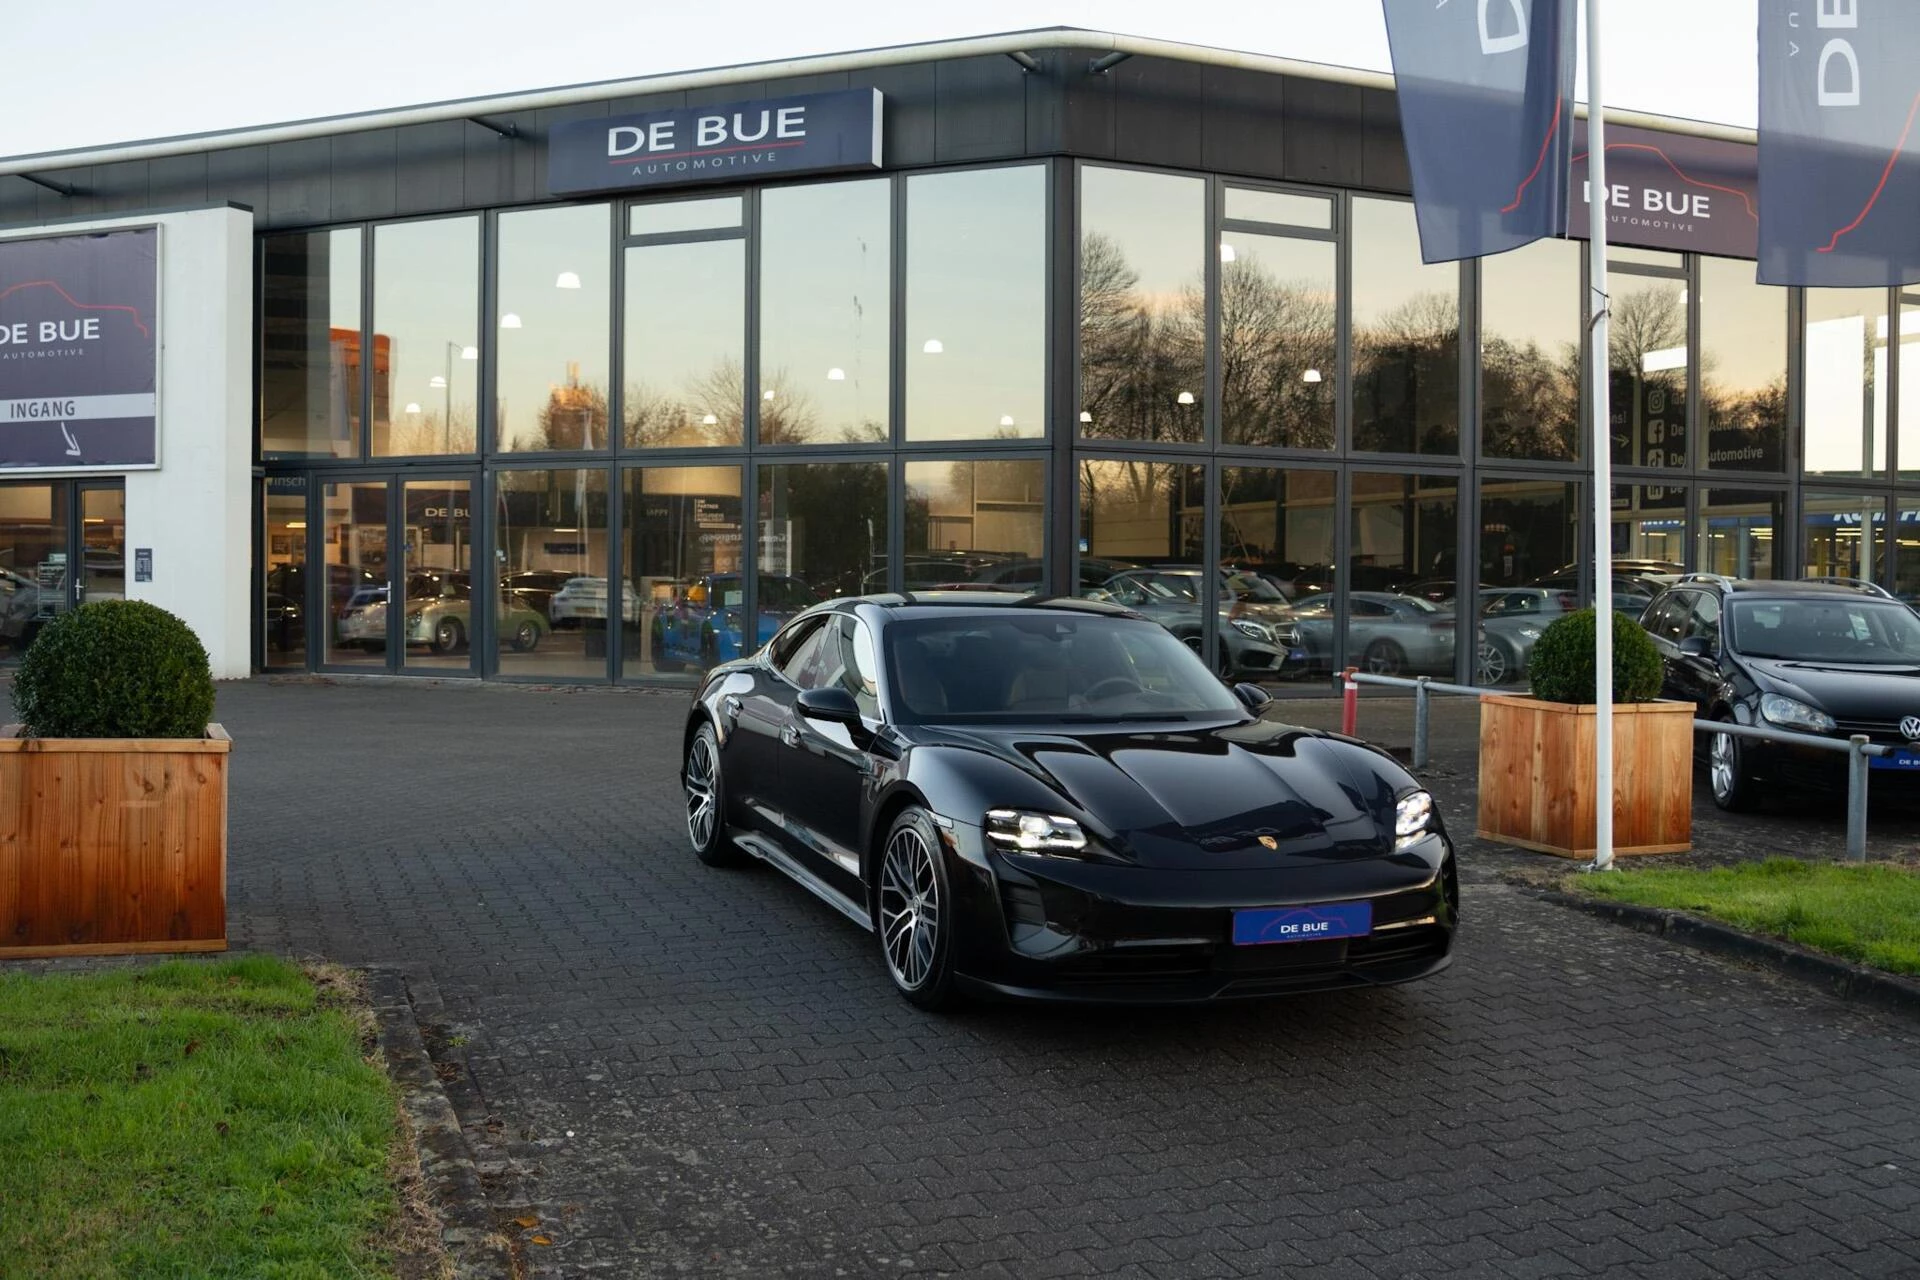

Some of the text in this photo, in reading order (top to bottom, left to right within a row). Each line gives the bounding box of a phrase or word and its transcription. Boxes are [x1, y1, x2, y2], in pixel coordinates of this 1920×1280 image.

[608, 106, 806, 157] DE BUE
[632, 152, 777, 176] AUTOMOTIVE
[1643, 188, 1711, 219] BUE
[39, 318, 100, 343] BUE
[3, 348, 84, 360] AUTOMOTIVE
[10, 400, 76, 418] INGANG
[1709, 446, 1764, 462] utomotive
[424, 507, 449, 517] DE
[1280, 921, 1329, 934] DE BUE
